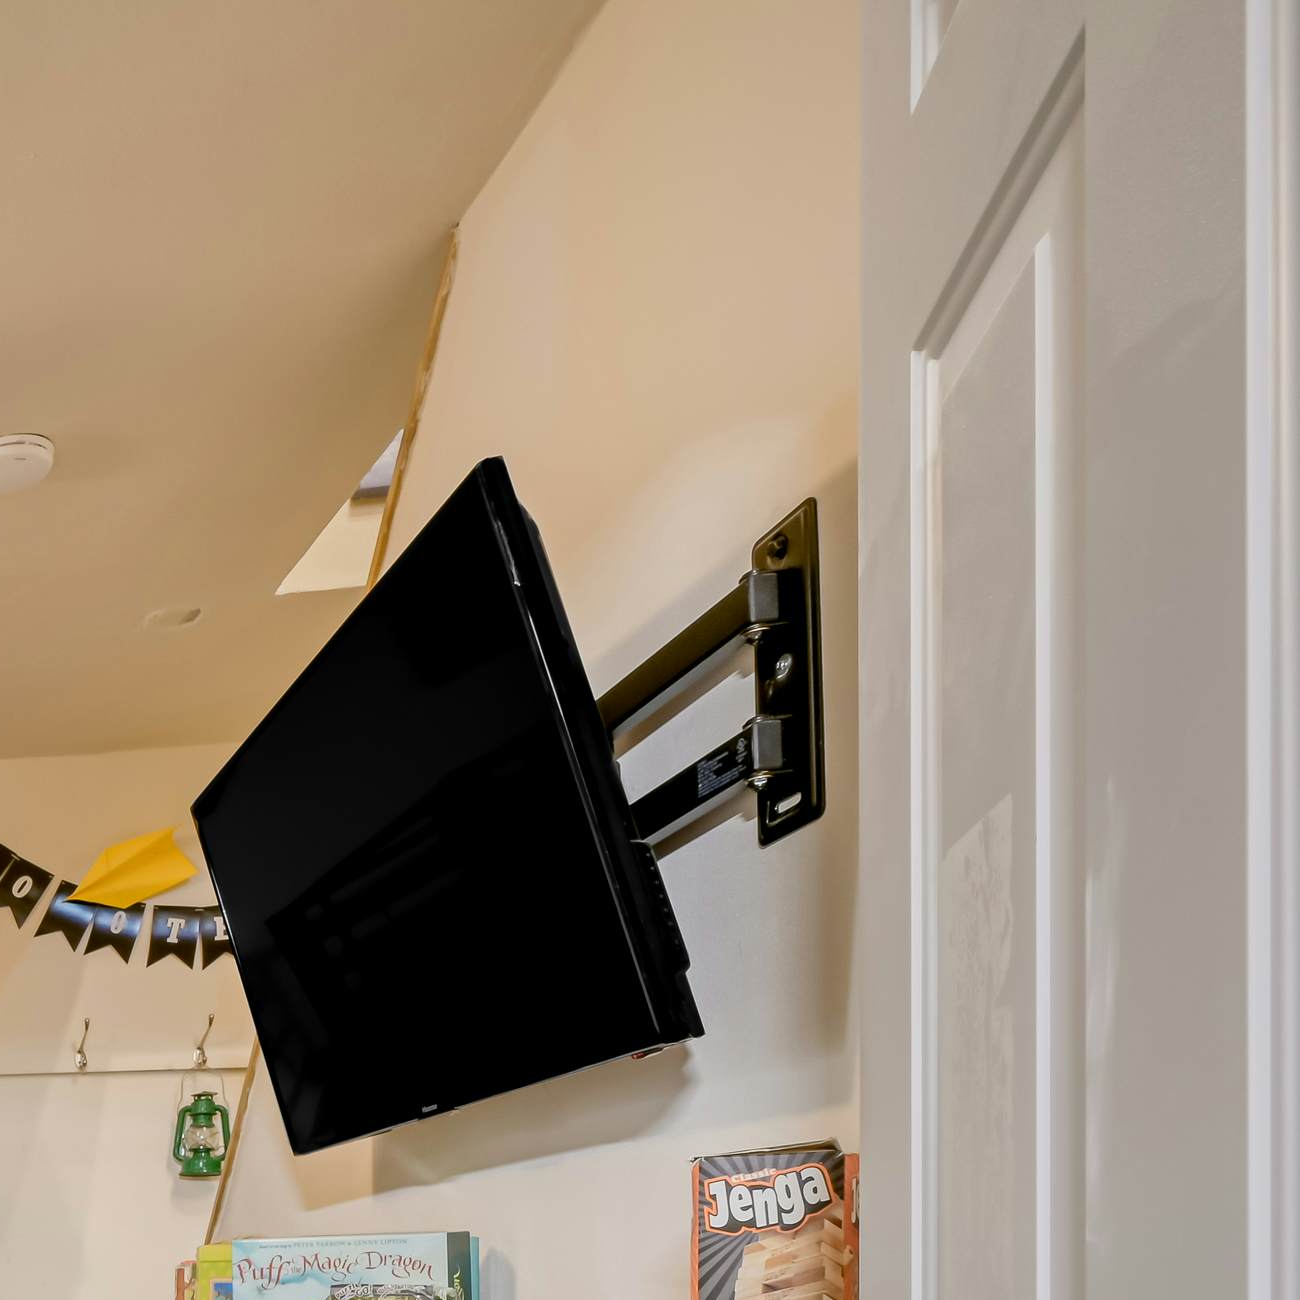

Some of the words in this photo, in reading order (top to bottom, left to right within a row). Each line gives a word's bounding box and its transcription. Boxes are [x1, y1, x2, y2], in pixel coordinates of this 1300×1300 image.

[708, 1166, 831, 1229] Jenga
[235, 1254, 290, 1291] Puff
[299, 1251, 358, 1282] Magic
[361, 1251, 435, 1280] Dragon
